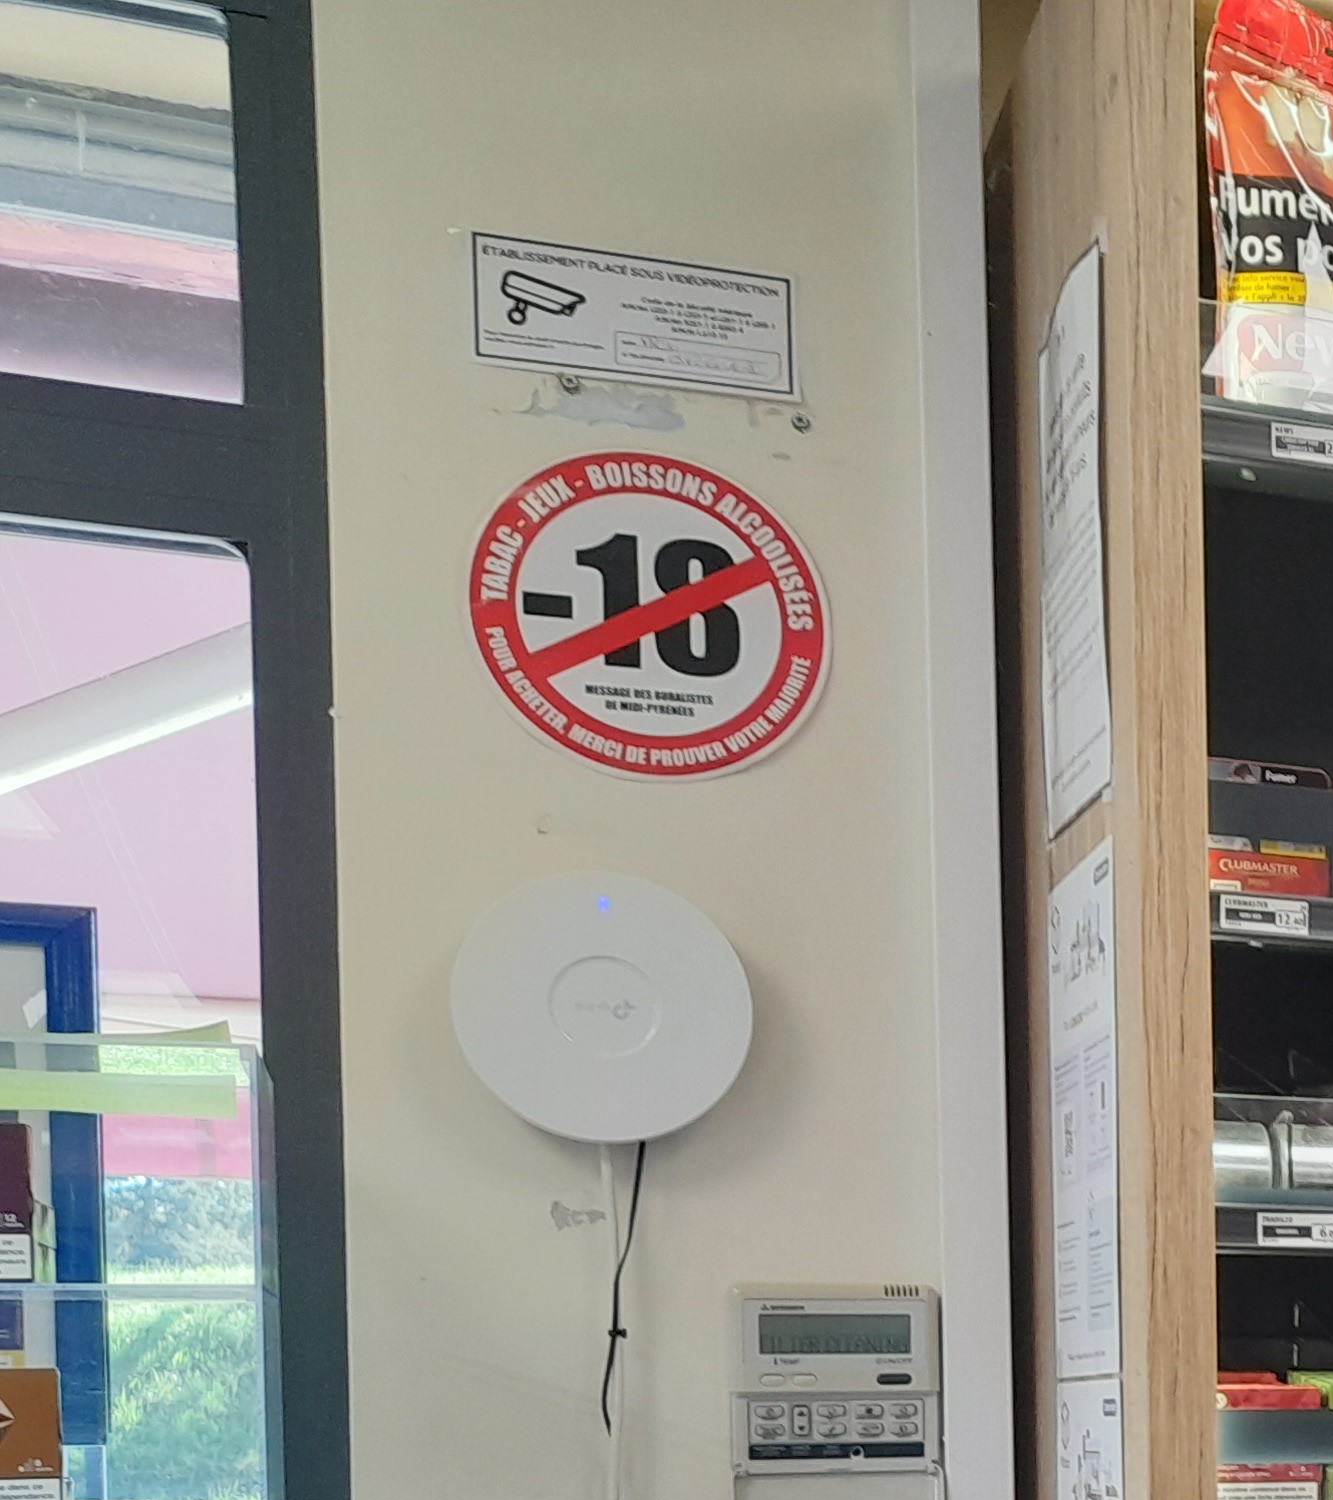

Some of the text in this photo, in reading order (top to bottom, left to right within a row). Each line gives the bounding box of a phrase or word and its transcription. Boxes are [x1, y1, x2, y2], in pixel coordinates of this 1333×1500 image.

[480, 461, 814, 632] TABAC JEUX BOISSONS ALCOOLISÉES
[485, 625, 511, 679] POUR
[569, 722, 622, 760] MERCI
[625, 745, 647, 765] DE
[650, 741, 727, 767] PROUVER
[723, 714, 774, 754] VOTRE
[768, 654, 813, 727] MAJORITÉ
[585, 683, 714, 706] MESSAGE DES BURALISTES
[605, 699, 619, 711] DE
[1218, 858, 1300, 876] CLUBMASTER
